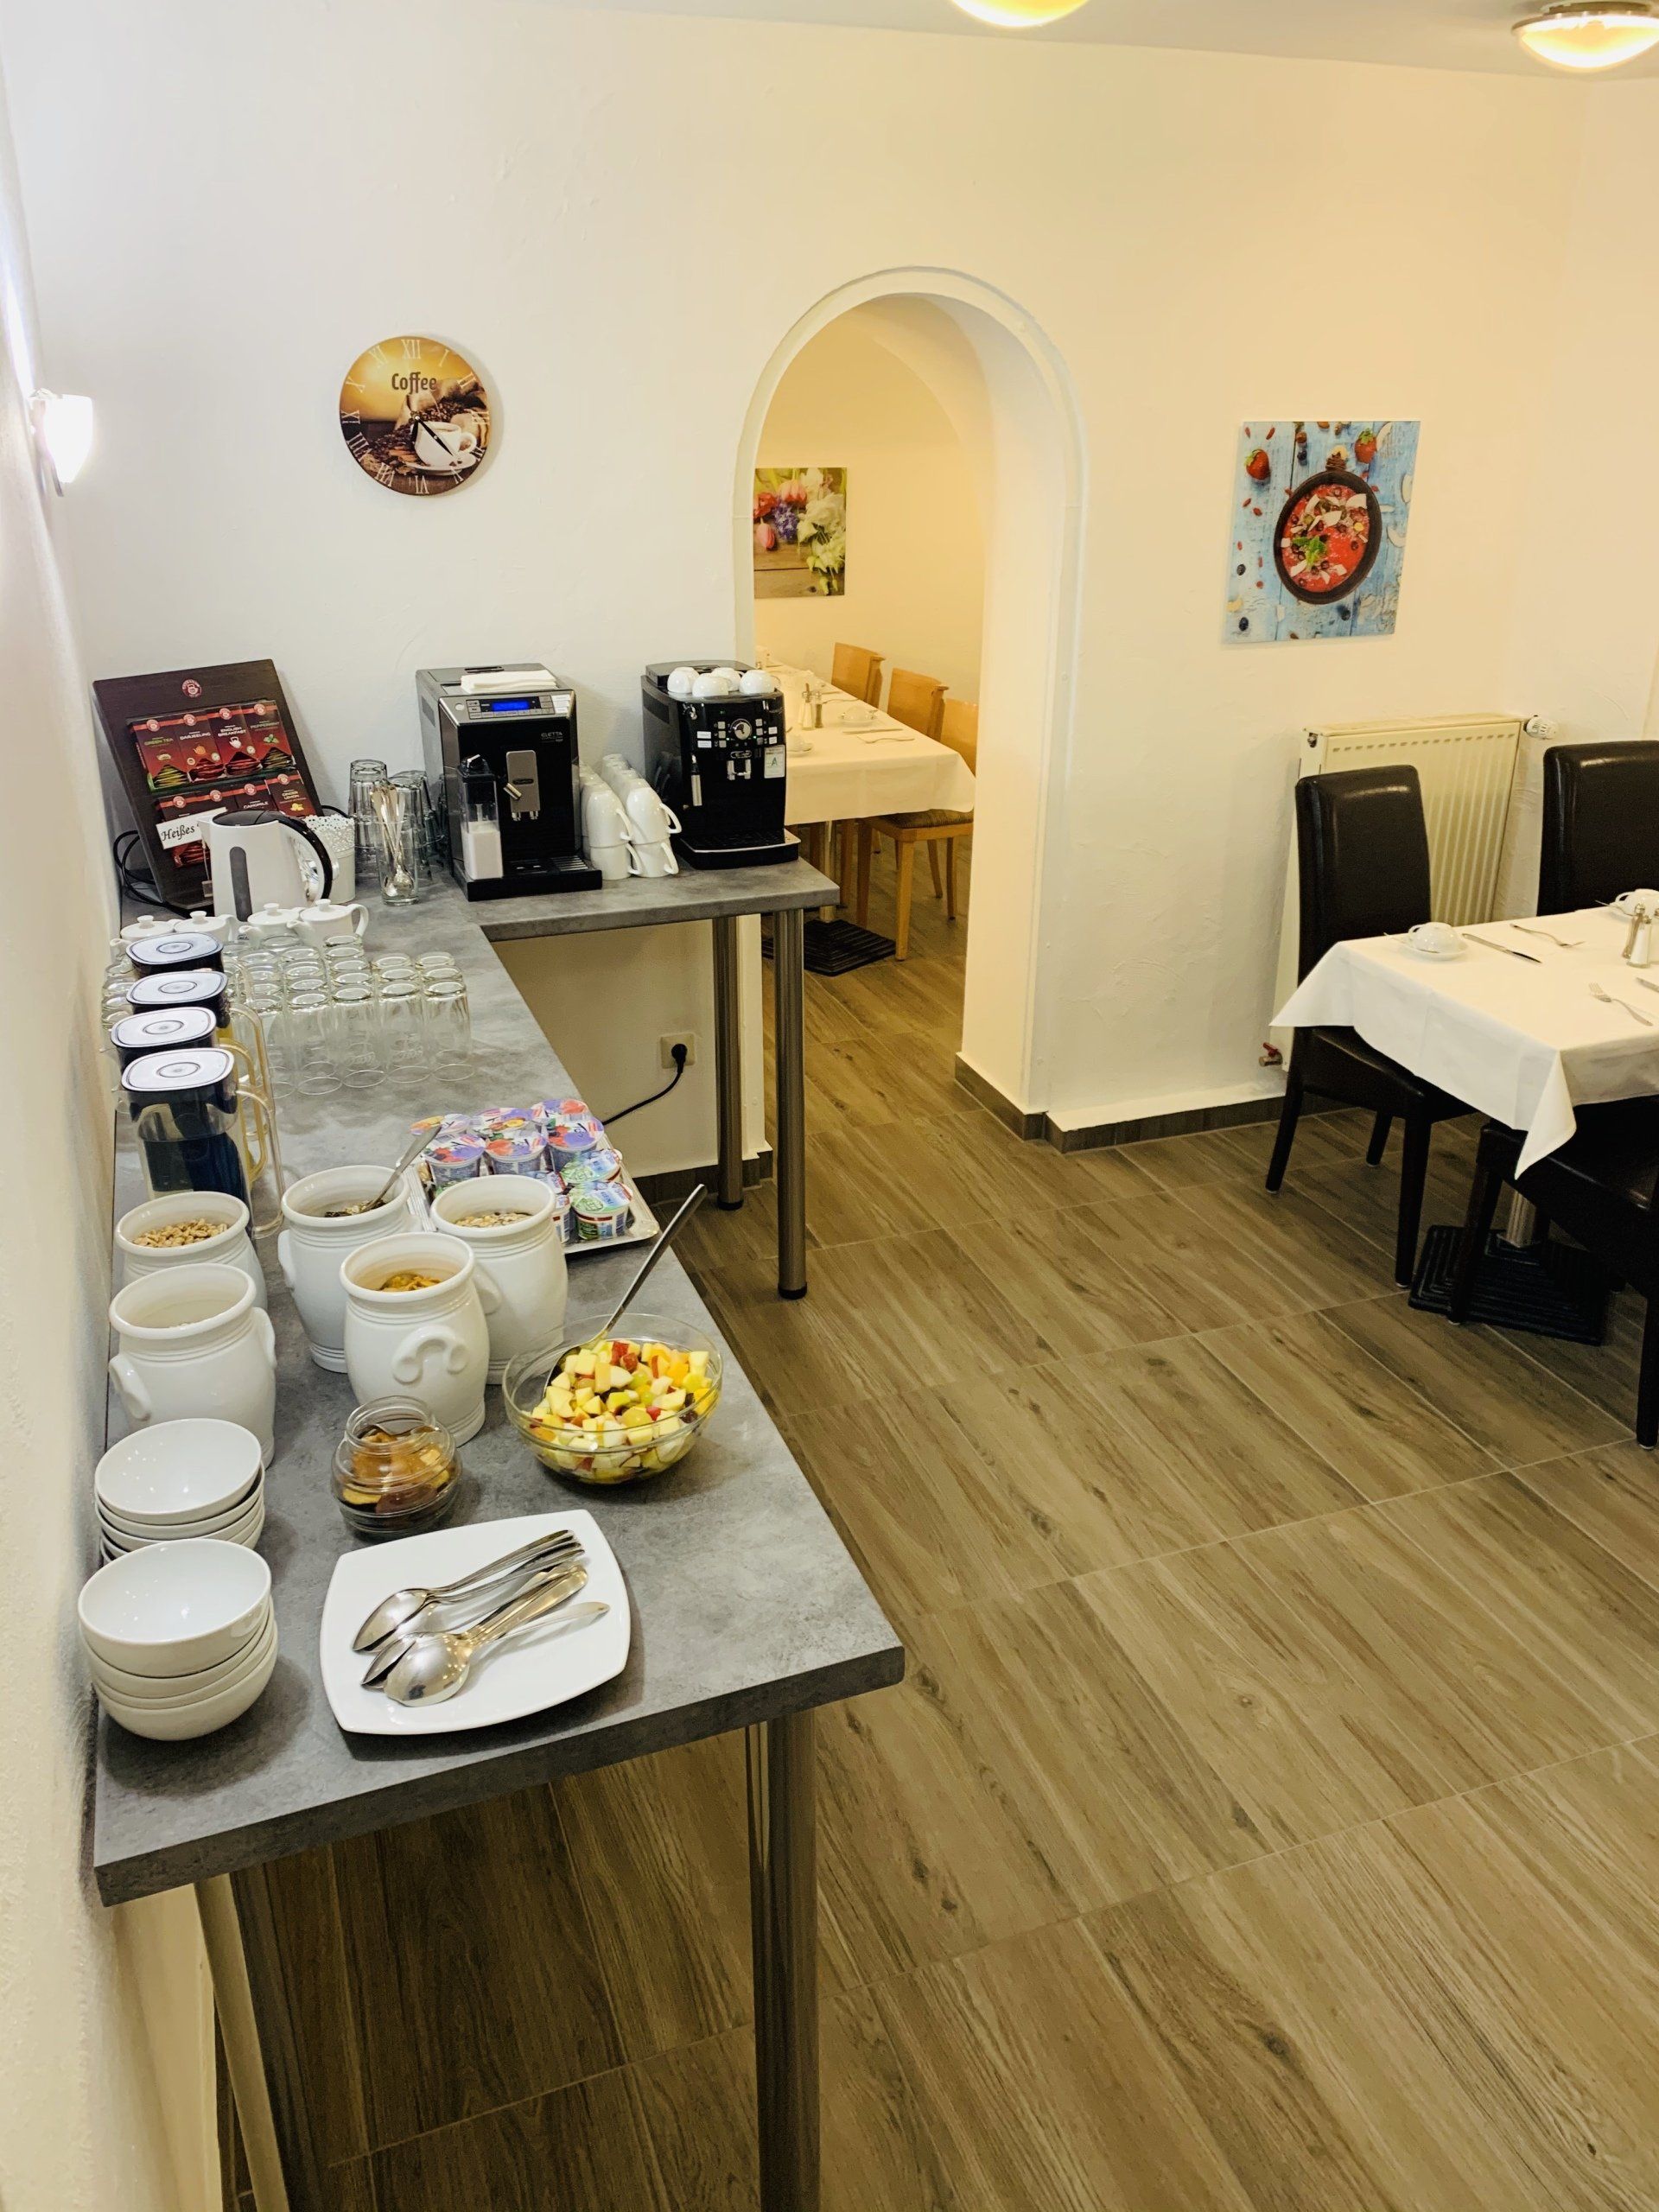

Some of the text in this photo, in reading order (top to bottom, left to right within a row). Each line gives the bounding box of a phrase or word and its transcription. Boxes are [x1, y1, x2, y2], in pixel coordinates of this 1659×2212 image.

[401, 339, 421, 359] XII
[391, 372, 437, 394] Coffee
[180, 732, 211, 741] DARJEELING
[161, 824, 195, 842] Heißes
